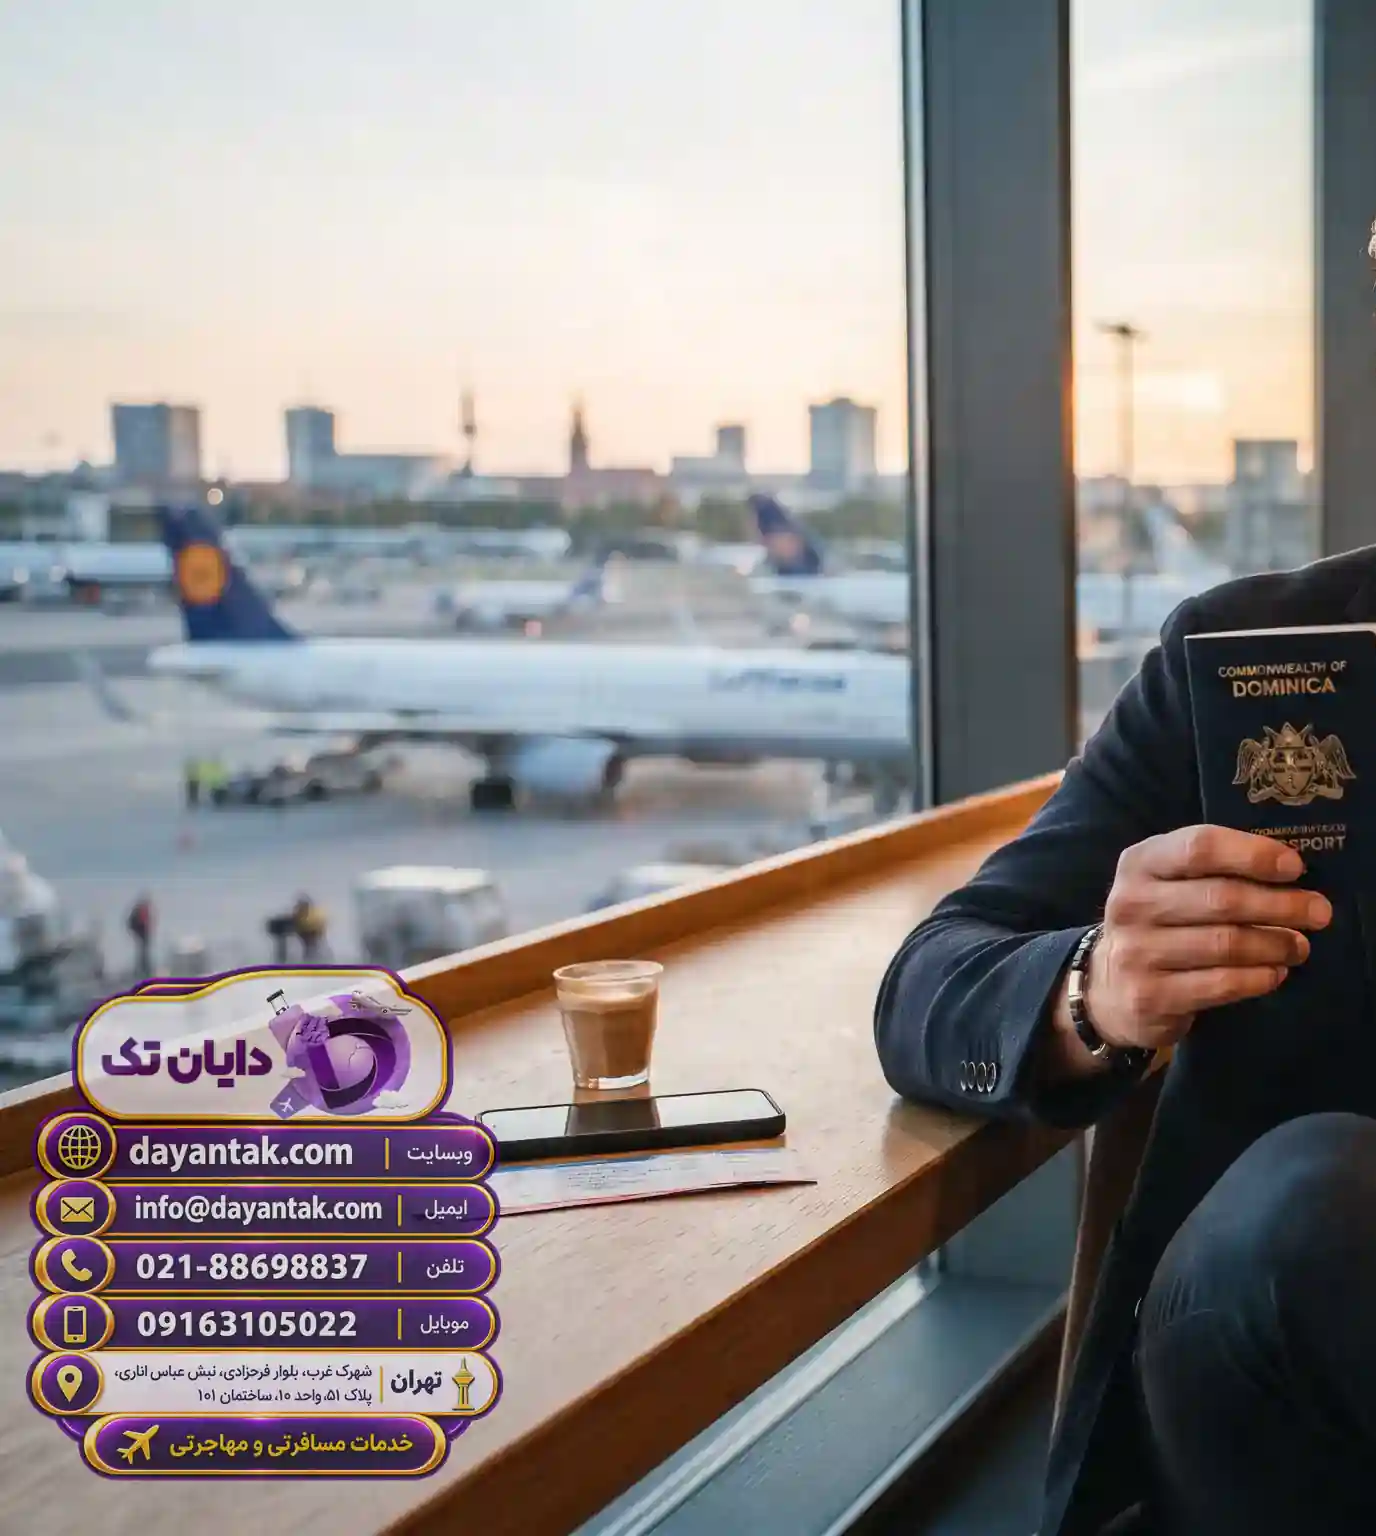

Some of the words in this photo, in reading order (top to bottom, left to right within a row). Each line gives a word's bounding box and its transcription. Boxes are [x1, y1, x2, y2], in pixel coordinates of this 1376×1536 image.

[1217, 661, 1327, 678] COMMONWEALTH
[1330, 660, 1348, 673] OF
[1231, 677, 1336, 698] DOMINICA
[1281, 835, 1347, 852] SPORT
